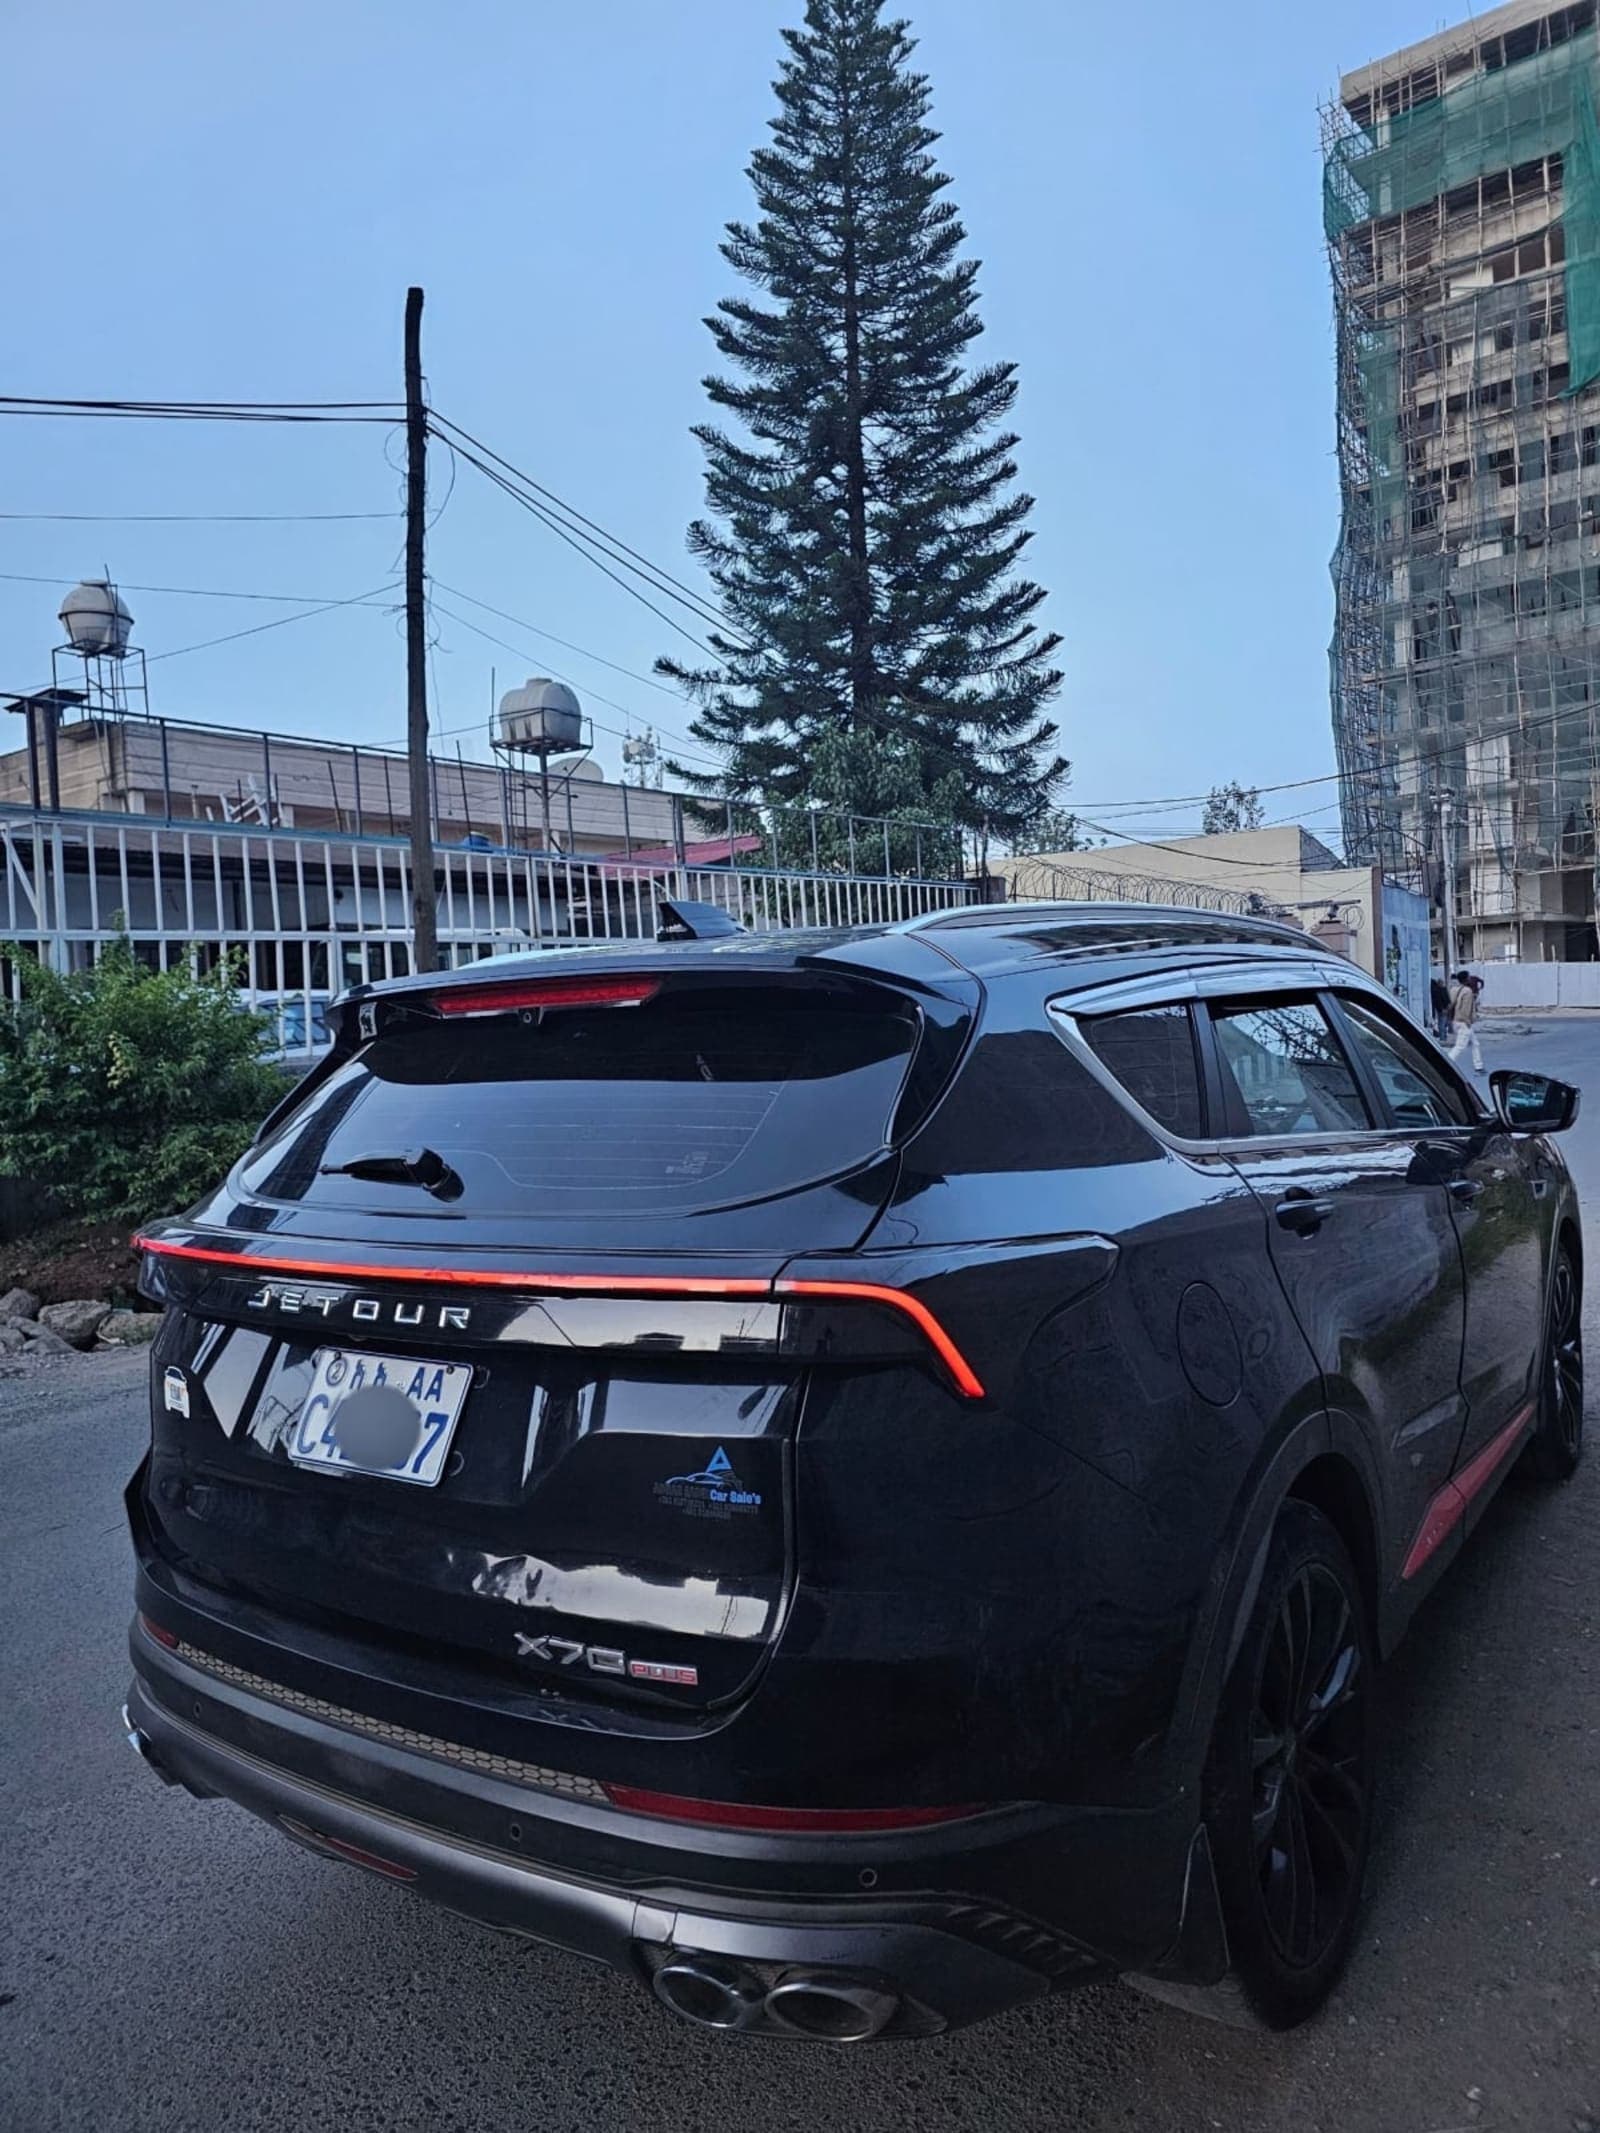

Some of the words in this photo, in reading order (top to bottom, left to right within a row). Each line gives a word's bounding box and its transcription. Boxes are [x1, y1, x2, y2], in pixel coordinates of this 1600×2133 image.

[247, 1287, 471, 1329] JETOUR
[406, 1365, 446, 1403] AA
[297, 1393, 450, 1474] C47
[710, 1489, 729, 1502] Car
[513, 1631, 626, 1676] X70
